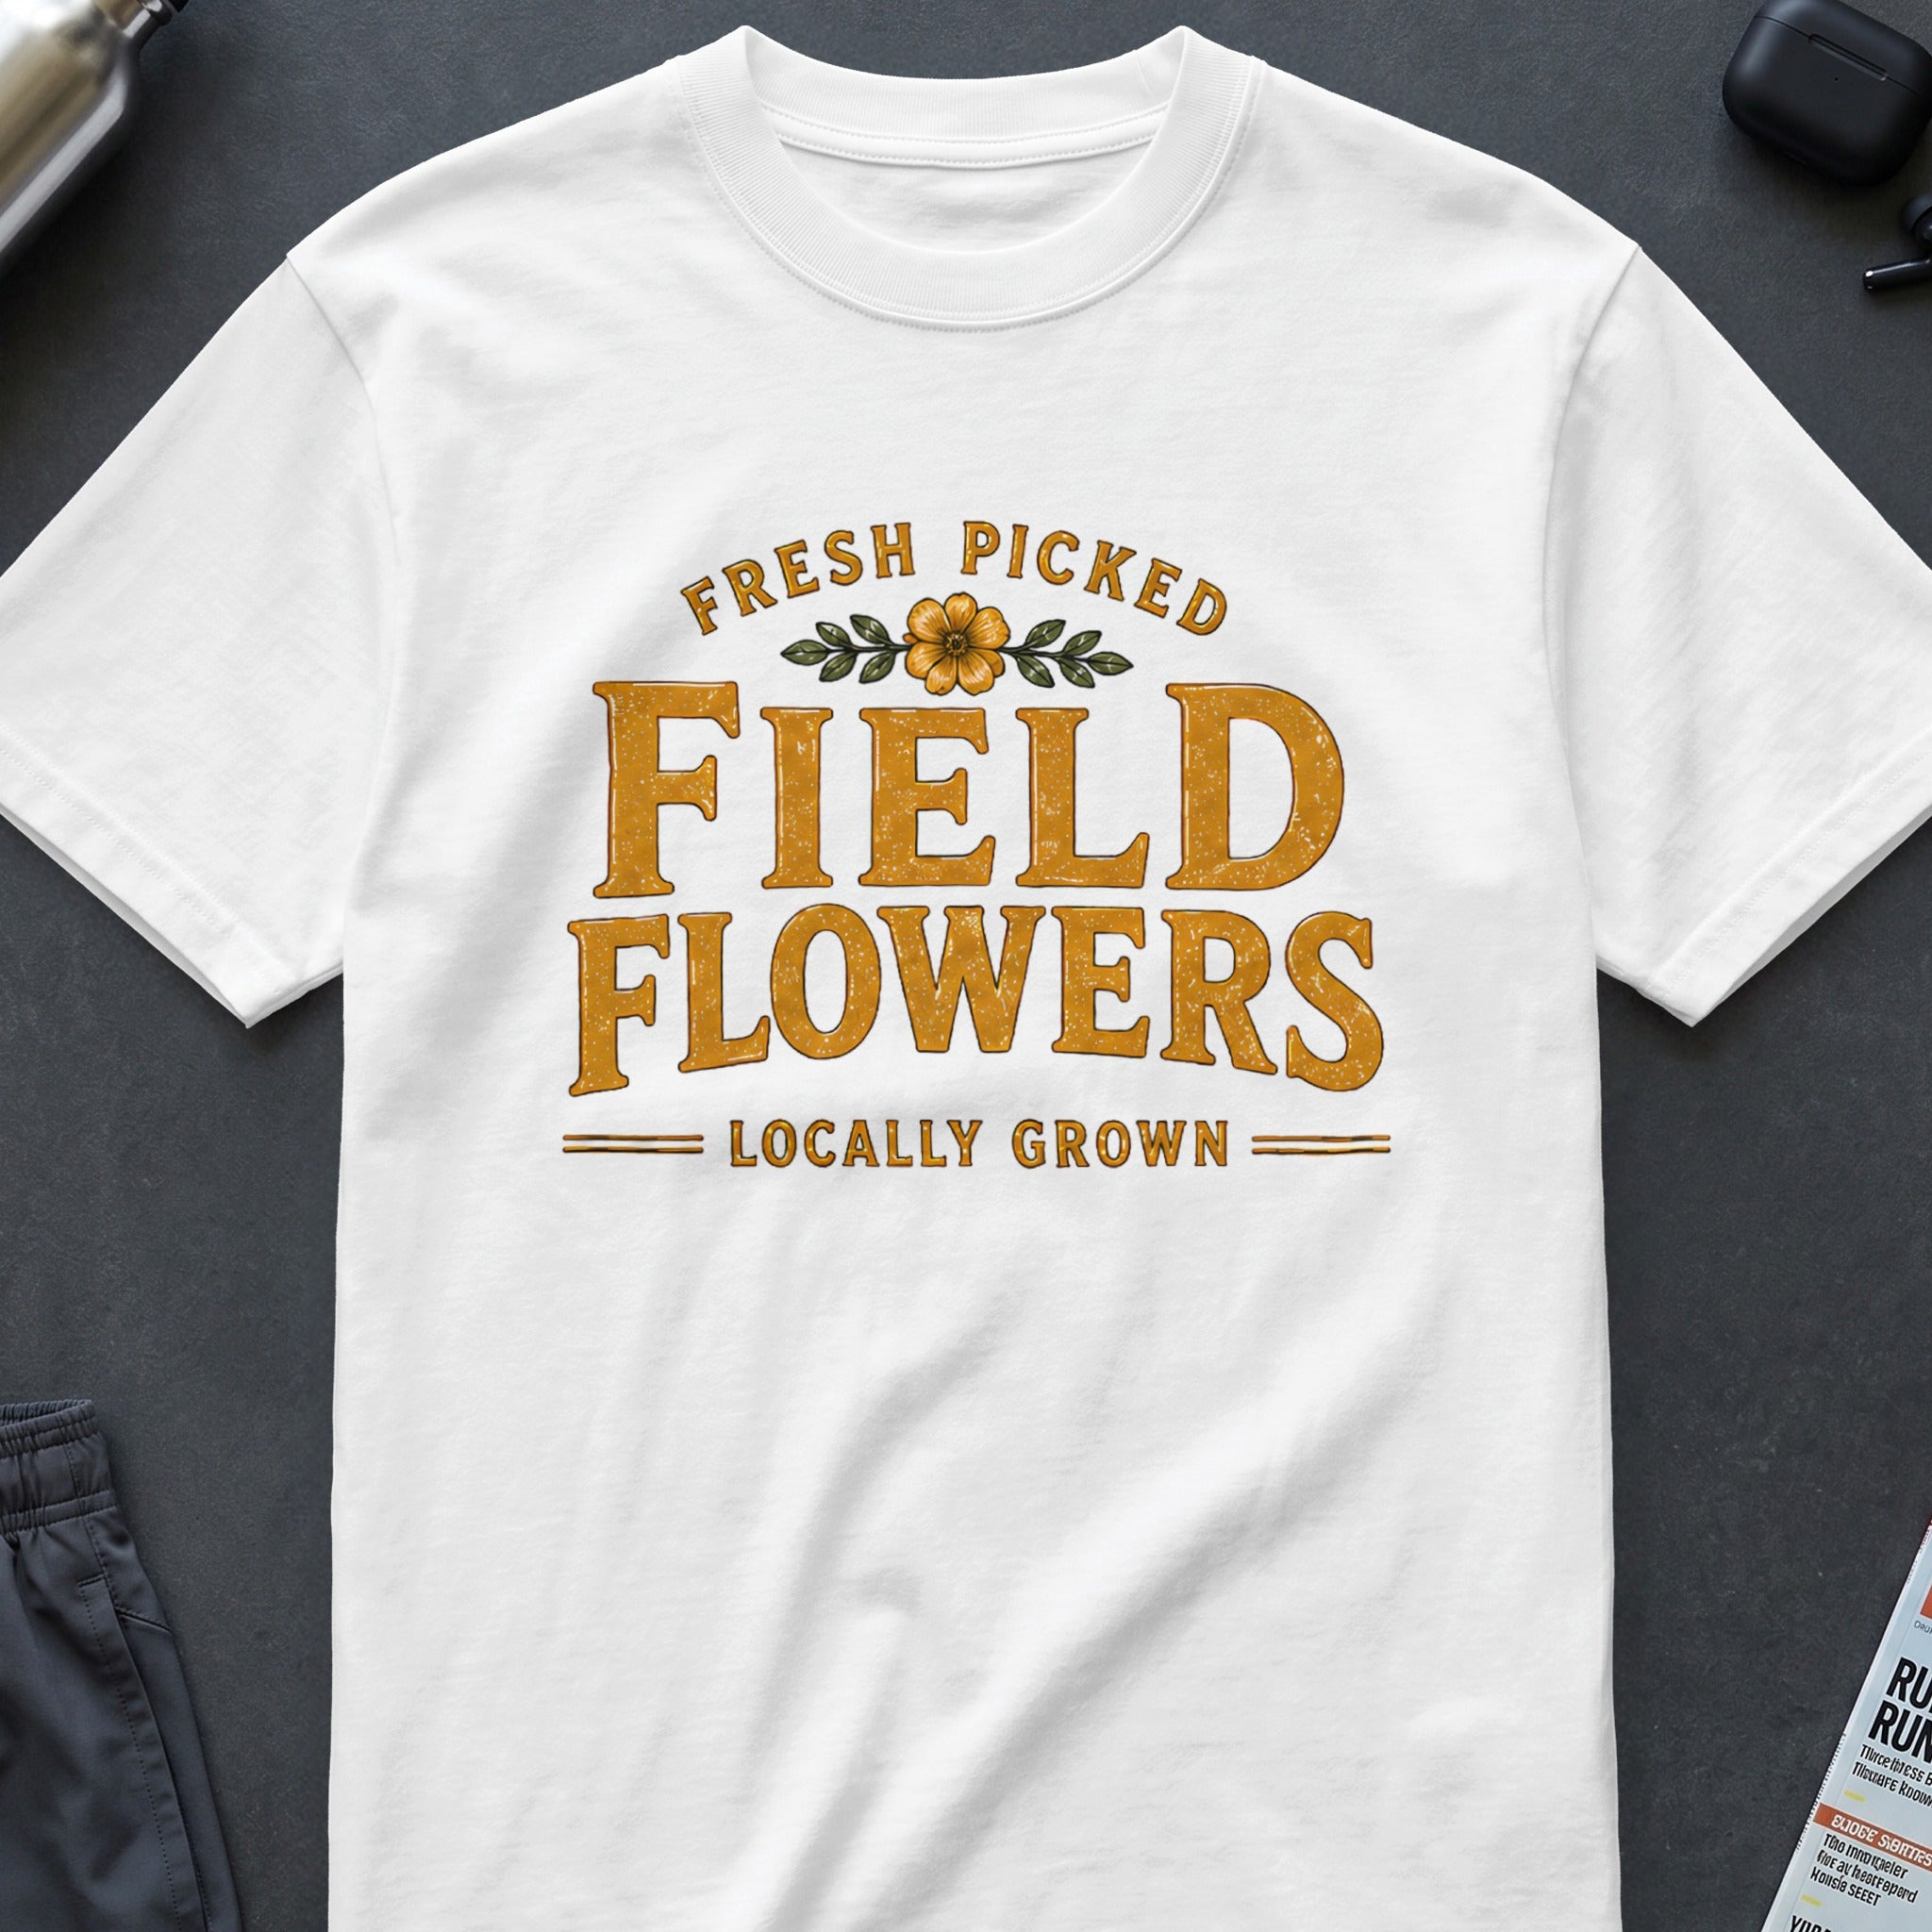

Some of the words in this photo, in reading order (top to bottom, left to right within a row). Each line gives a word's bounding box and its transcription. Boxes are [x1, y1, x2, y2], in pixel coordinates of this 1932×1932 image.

[680, 522, 915, 636] FRESH
[960, 521, 1227, 636] PICKED
[591, 680, 1345, 899] FIELD
[567, 903, 1385, 1097] FLOWERS
[729, 1119, 983, 1168] LOCALLY
[1011, 1118, 1228, 1169] GROWN
[1886, 1657, 1932, 1714] RU
